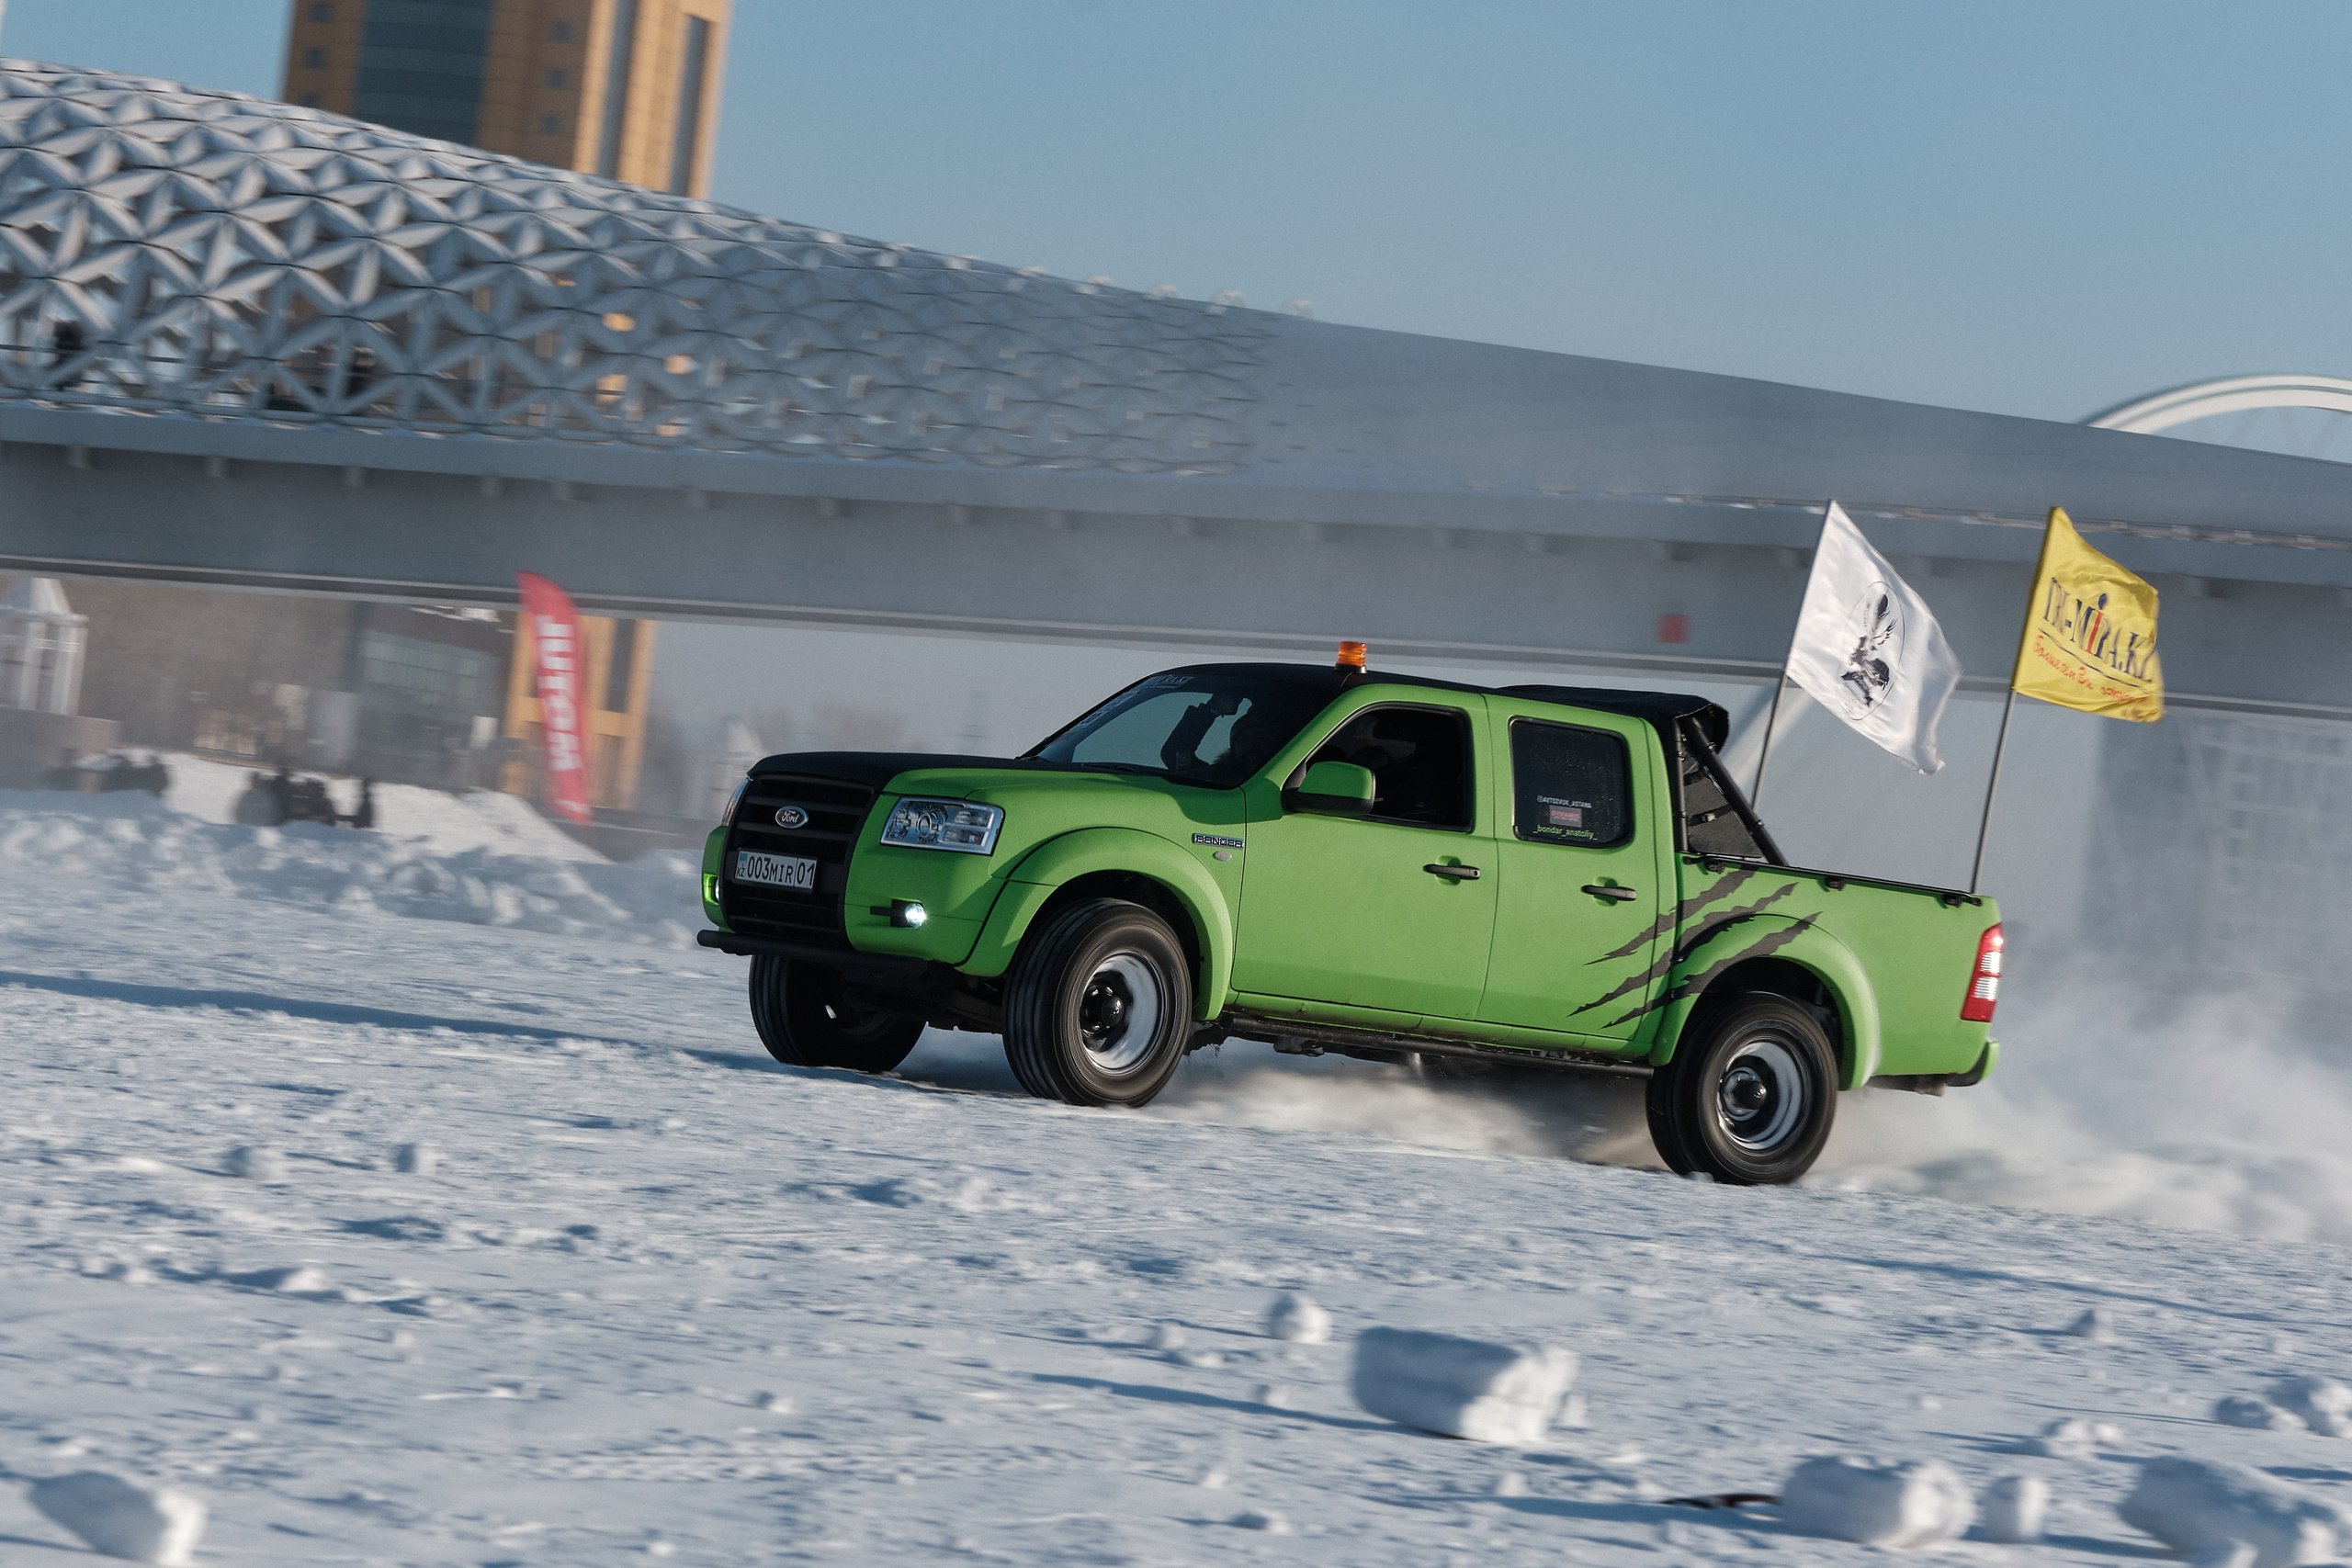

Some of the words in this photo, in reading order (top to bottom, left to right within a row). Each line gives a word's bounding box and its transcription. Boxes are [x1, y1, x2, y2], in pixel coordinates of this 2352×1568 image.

[781, 809, 799, 824] Ford
[1194, 835, 1244, 849] RANGER
[736, 866, 745, 878] KZ
[747, 854, 794, 884] 003MIR
[796, 859, 815, 886] 01
